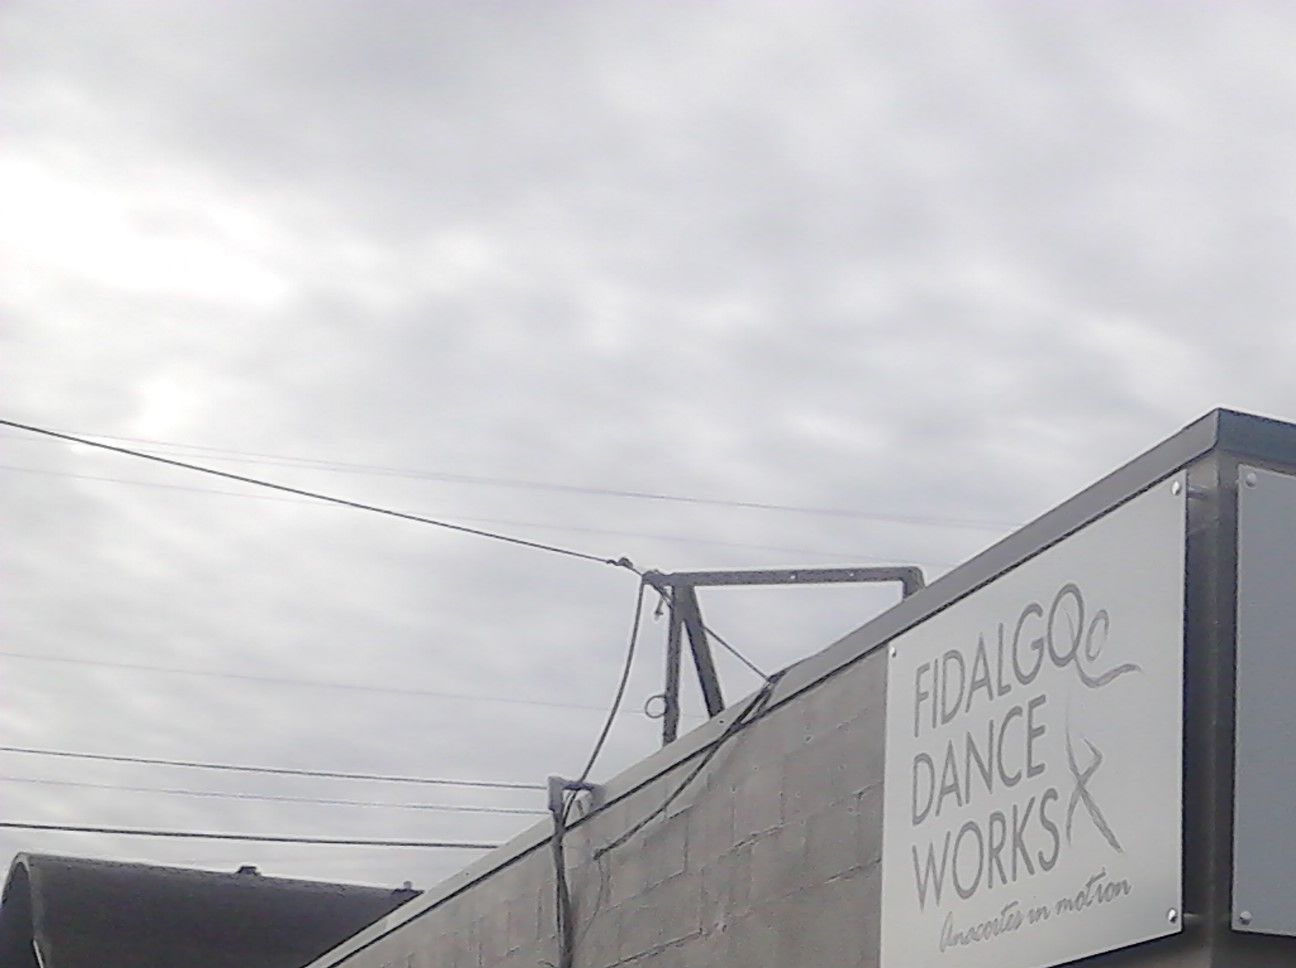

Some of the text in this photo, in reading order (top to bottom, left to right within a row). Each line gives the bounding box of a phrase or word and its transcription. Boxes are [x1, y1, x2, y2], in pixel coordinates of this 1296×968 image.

[914, 583, 1085, 738] FIDALGO
[912, 695, 1046, 825] DANCE
[912, 788, 1060, 911] WORKS
[940, 867, 1132, 953] Anacortes in motion
